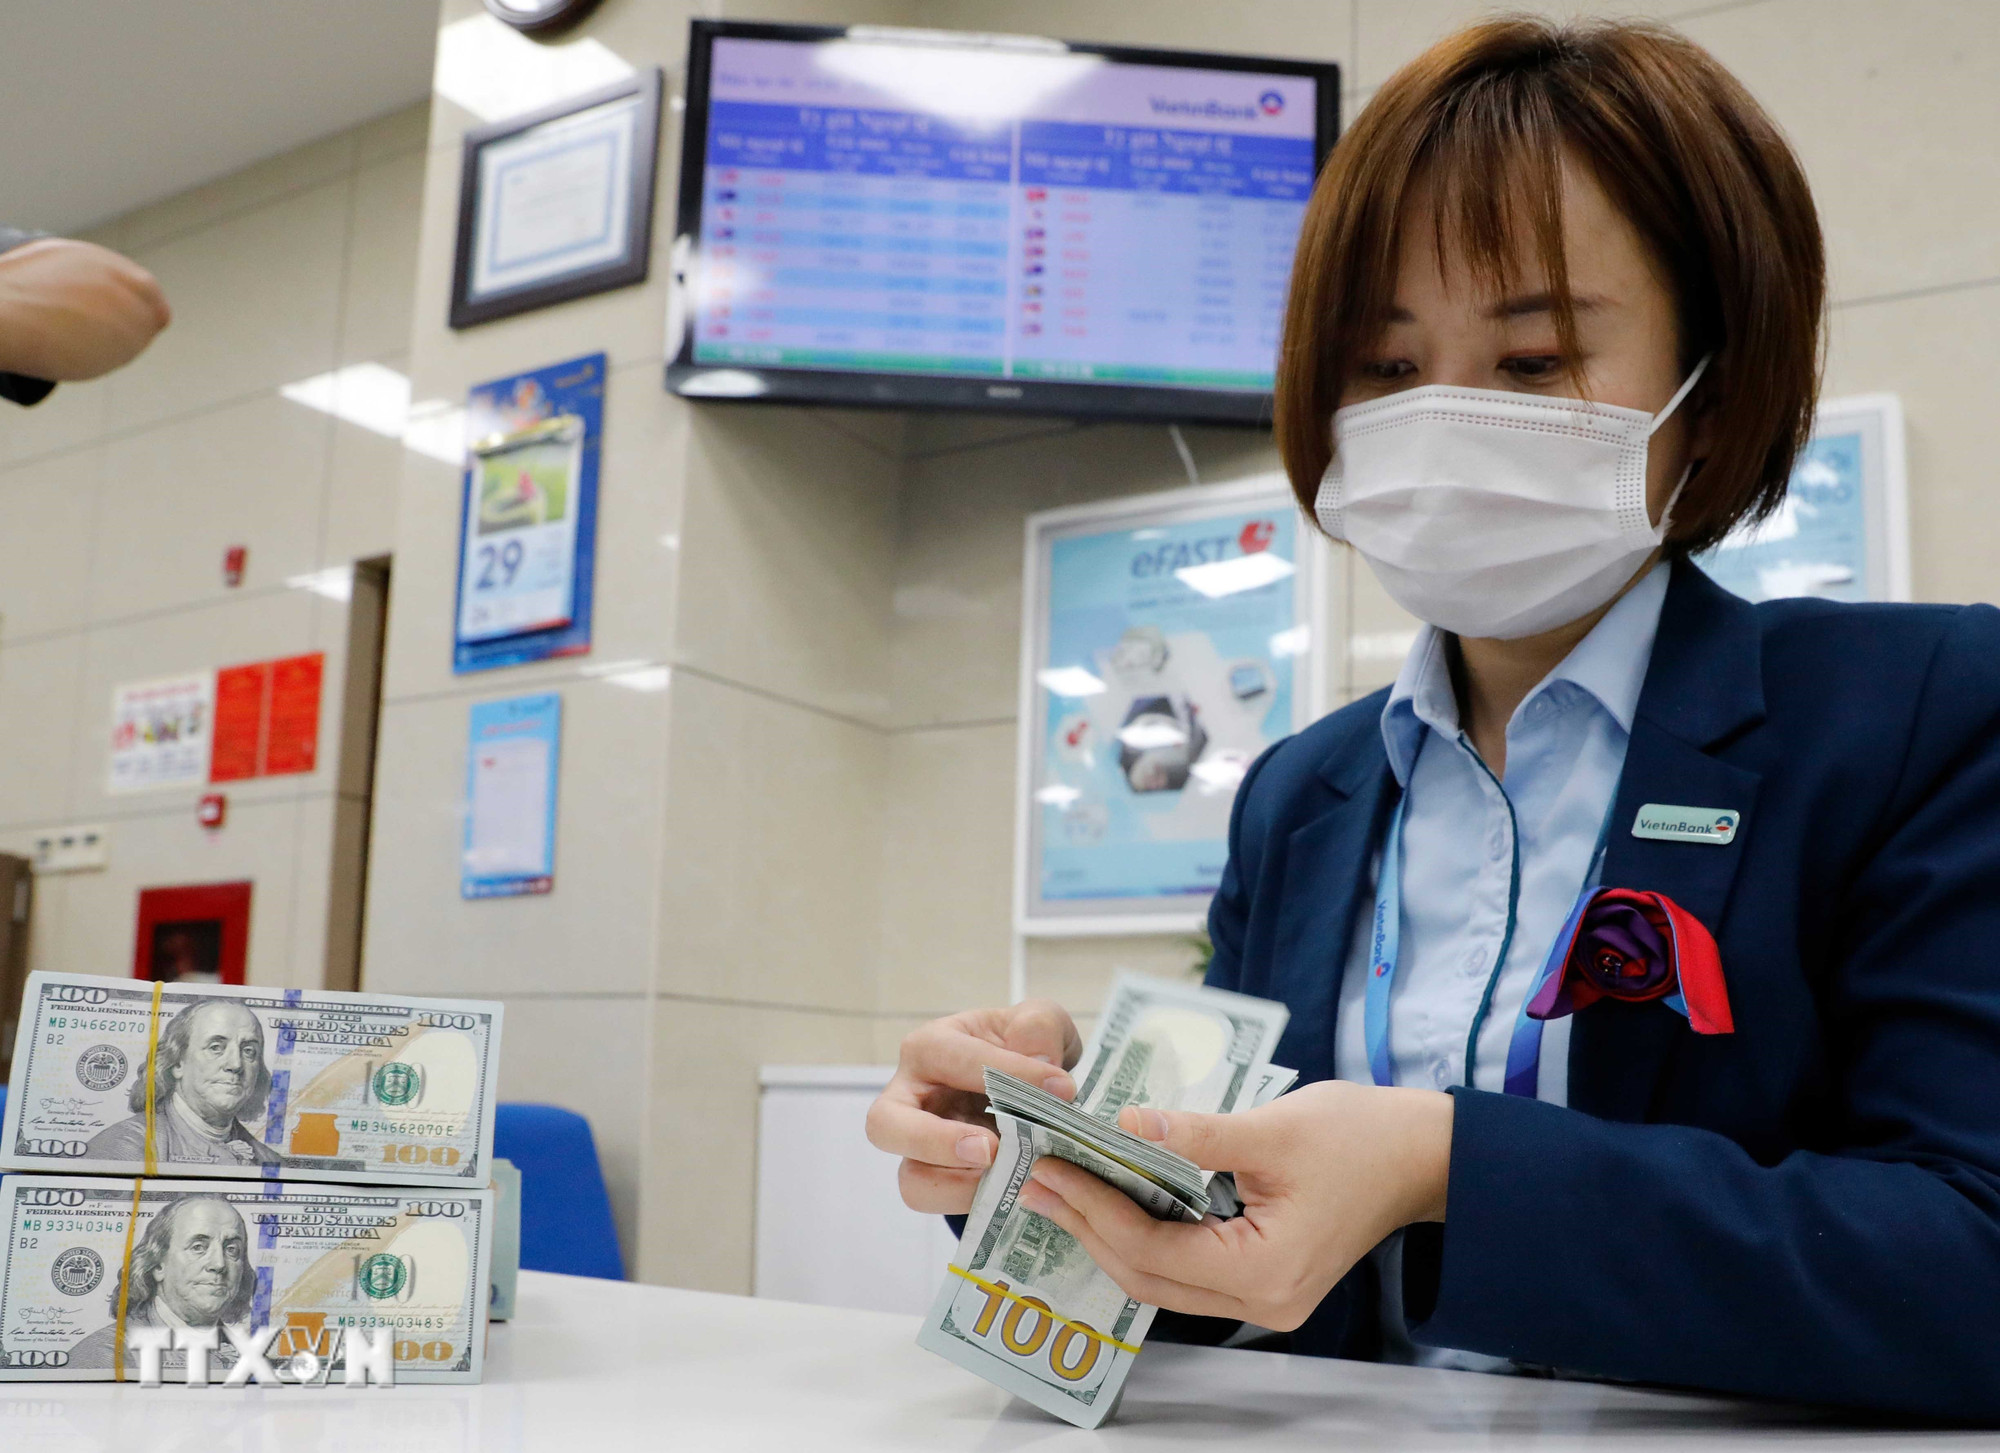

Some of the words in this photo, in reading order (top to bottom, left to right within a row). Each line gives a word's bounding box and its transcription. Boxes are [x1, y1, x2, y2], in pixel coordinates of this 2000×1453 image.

[476, 539, 523, 590] 29
[1131, 537, 1232, 578] eFAST
[1640, 819, 1713, 834] VietinBank
[1374, 900, 1387, 966] VietinBank
[46, 986, 109, 1004] 100
[50, 1004, 97, 1013] FEDERAL
[98, 1007, 145, 1016] RESERVE
[268, 1018, 339, 1032] UNITED
[340, 1022, 409, 1036] STATES
[417, 1012, 475, 1030] 100
[46, 1033, 65, 1046] B2
[308, 1033, 392, 1047] AMERICA
[26, 1138, 89, 1157] 100
[380, 1144, 460, 1166] 100
[20, 1189, 86, 1207] 100
[26, 1208, 74, 1216] FEDERAL
[405, 1201, 465, 1218] 100
[251, 1213, 323, 1225] UNITED
[325, 1215, 397, 1227] STATES
[291, 1227, 381, 1239] AMERICA
[20, 1237, 38, 1249] B2
[972, 1279, 1101, 1381] 100
[6, 1350, 70, 1368] 100
[392, 1340, 454, 1362] 00
